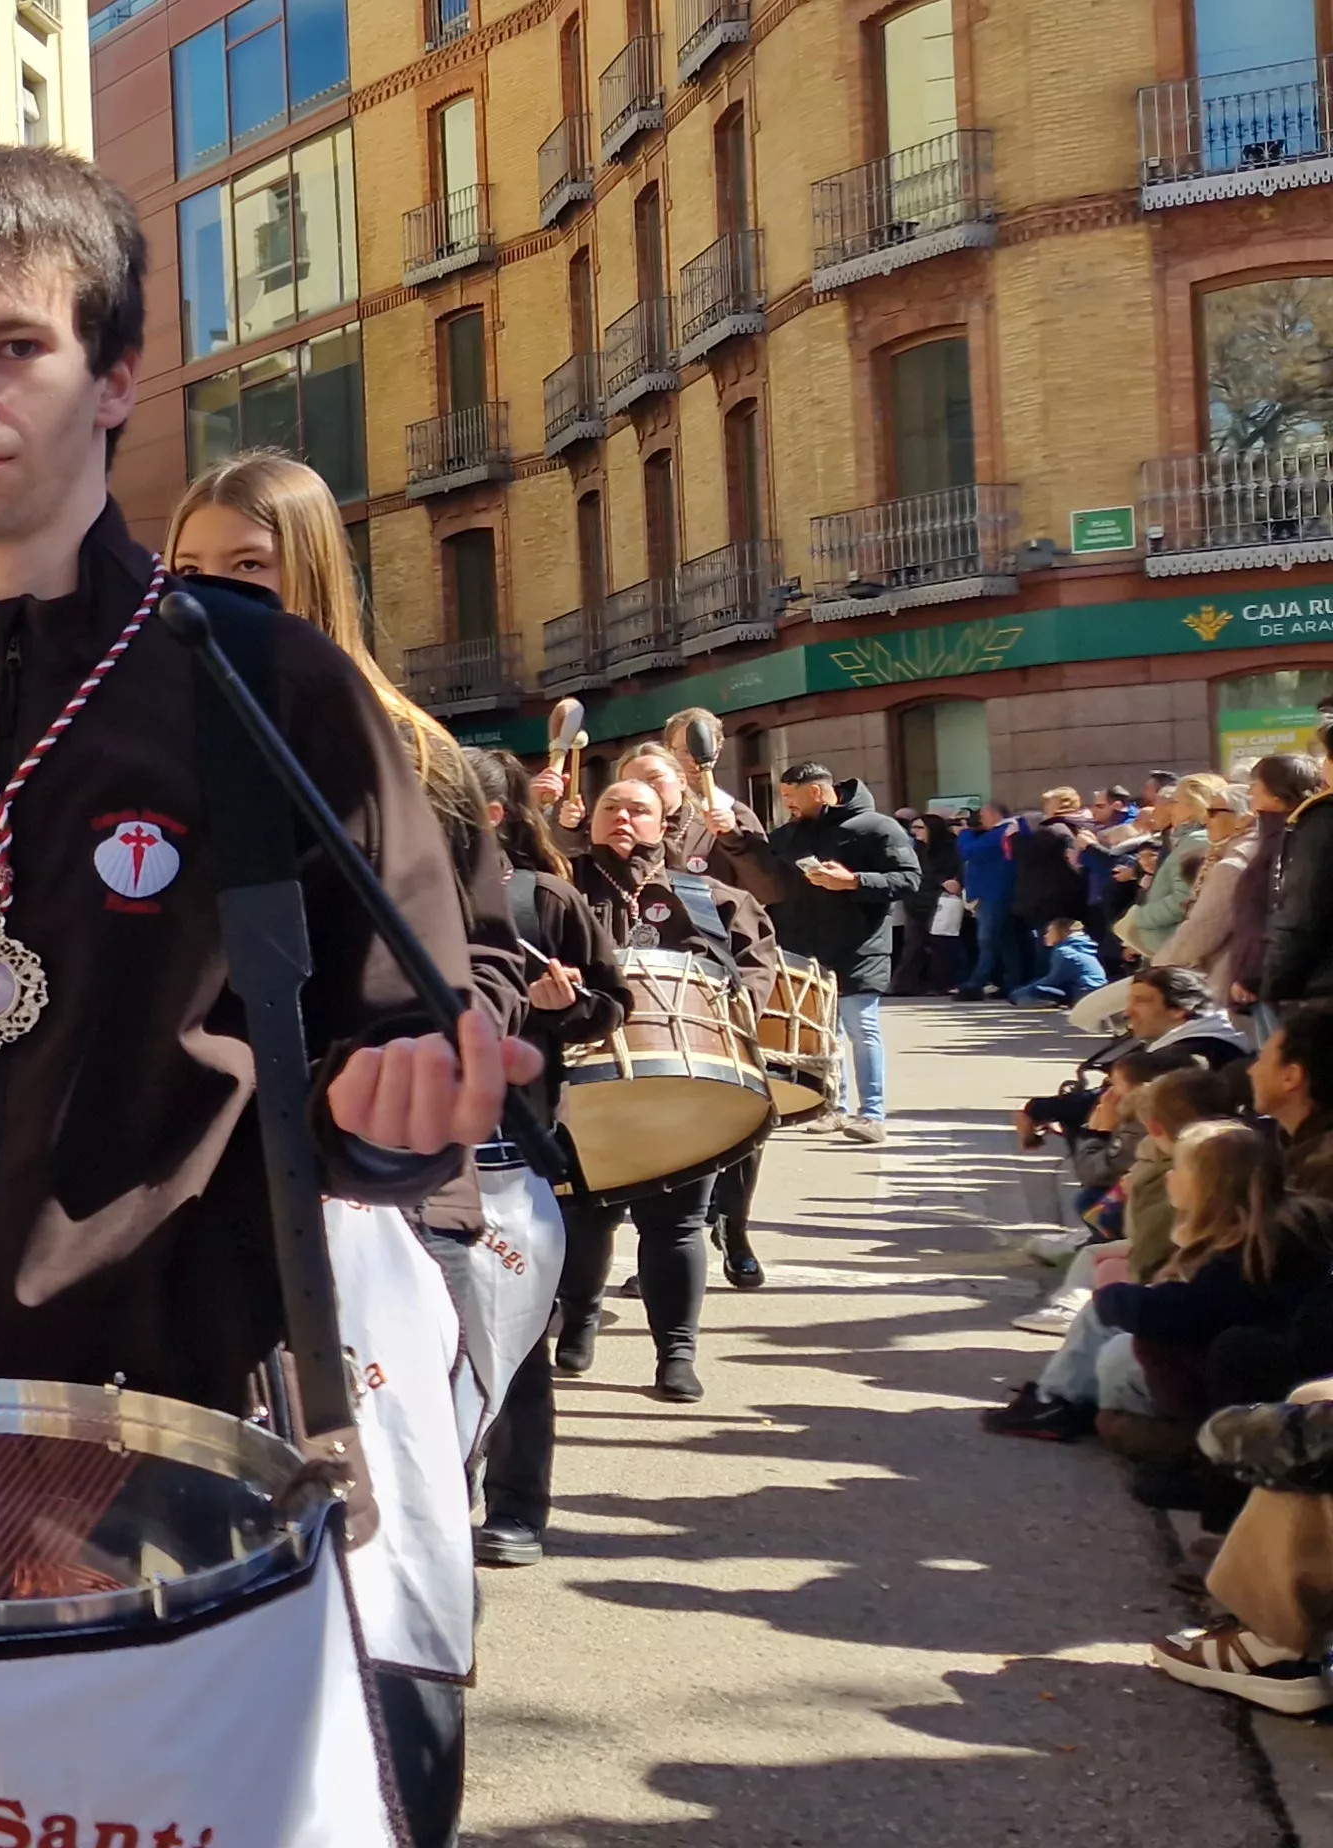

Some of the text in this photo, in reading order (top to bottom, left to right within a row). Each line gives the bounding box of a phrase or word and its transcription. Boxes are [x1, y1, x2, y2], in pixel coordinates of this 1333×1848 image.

[1242, 602, 1304, 621] CAJA
[1259, 619, 1333, 637] DE ARA
